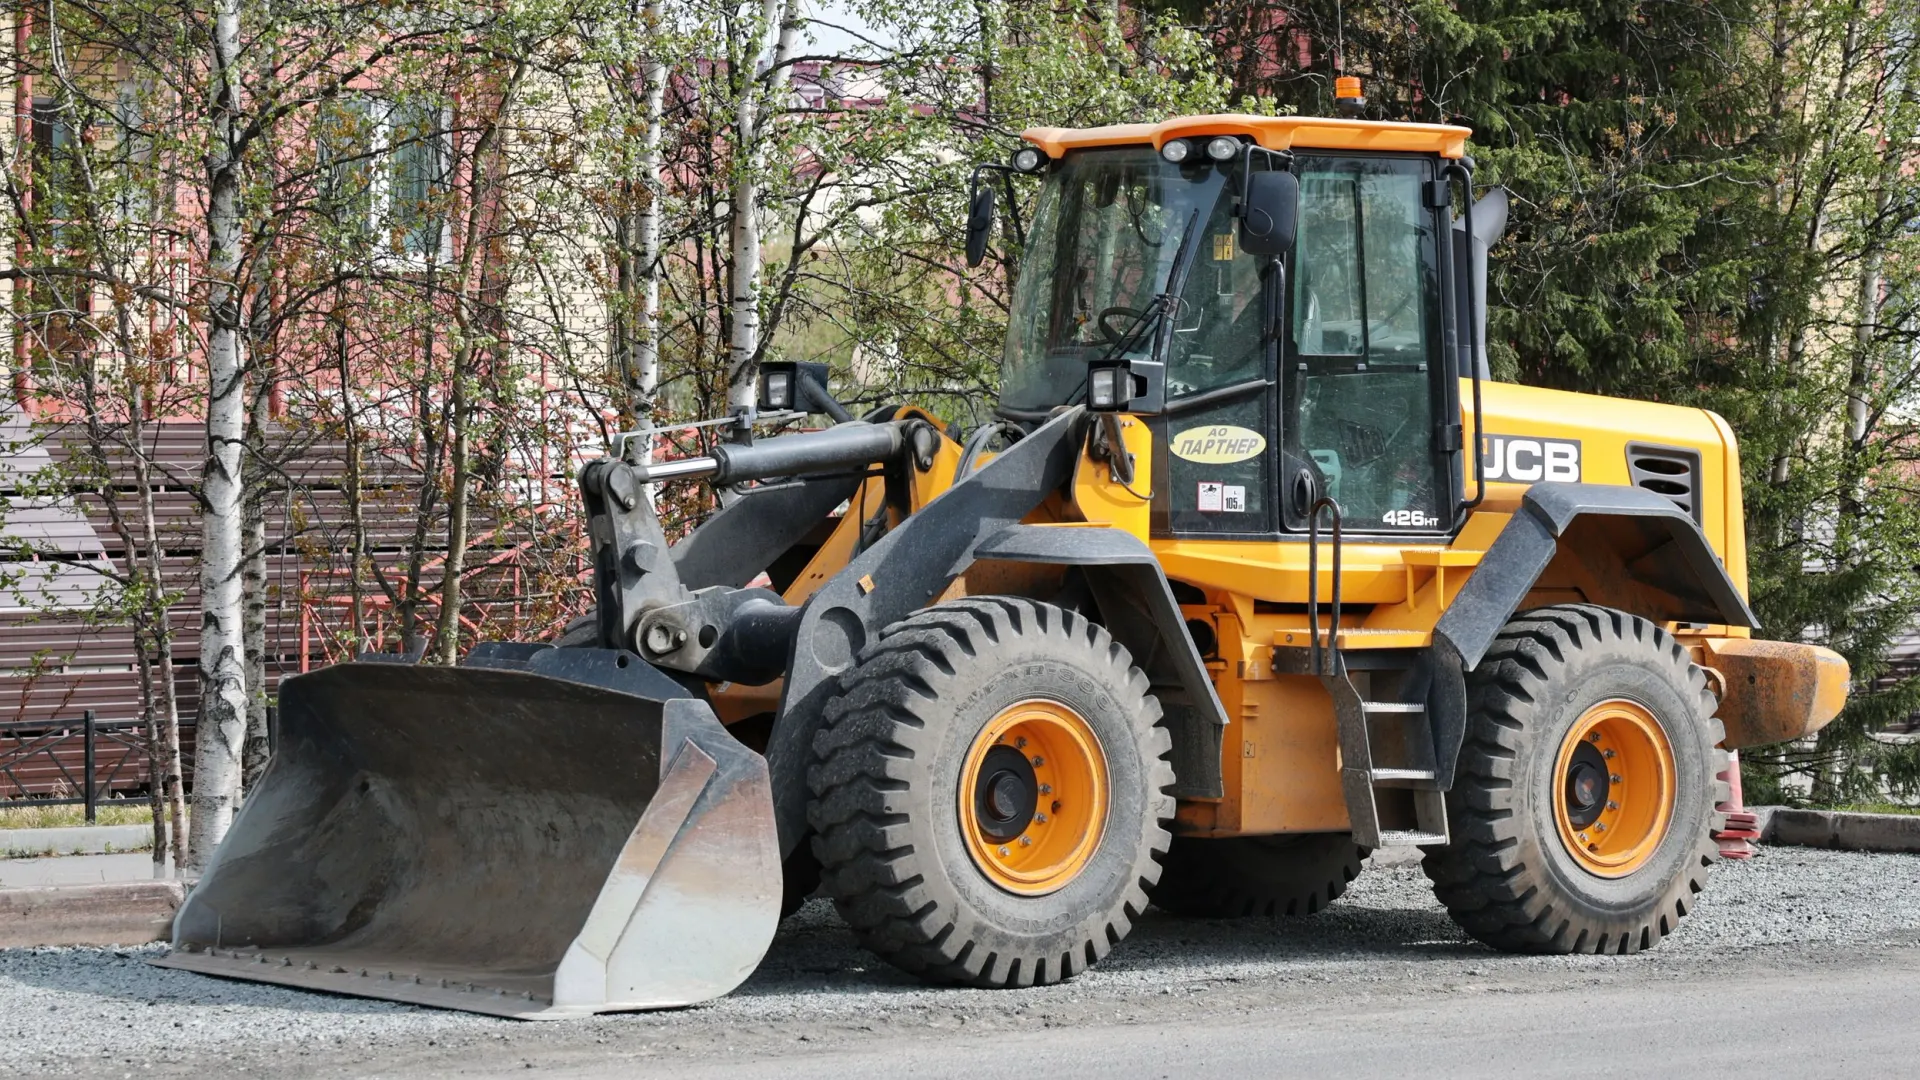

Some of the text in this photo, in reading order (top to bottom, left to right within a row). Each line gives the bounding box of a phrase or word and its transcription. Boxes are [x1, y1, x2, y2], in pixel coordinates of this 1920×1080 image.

[1208, 427, 1228, 437] АО
[1179, 438, 1259, 456] ПАРТНЕР
[1483, 438, 1580, 483] JCB
[1225, 497, 1238, 509] 105
